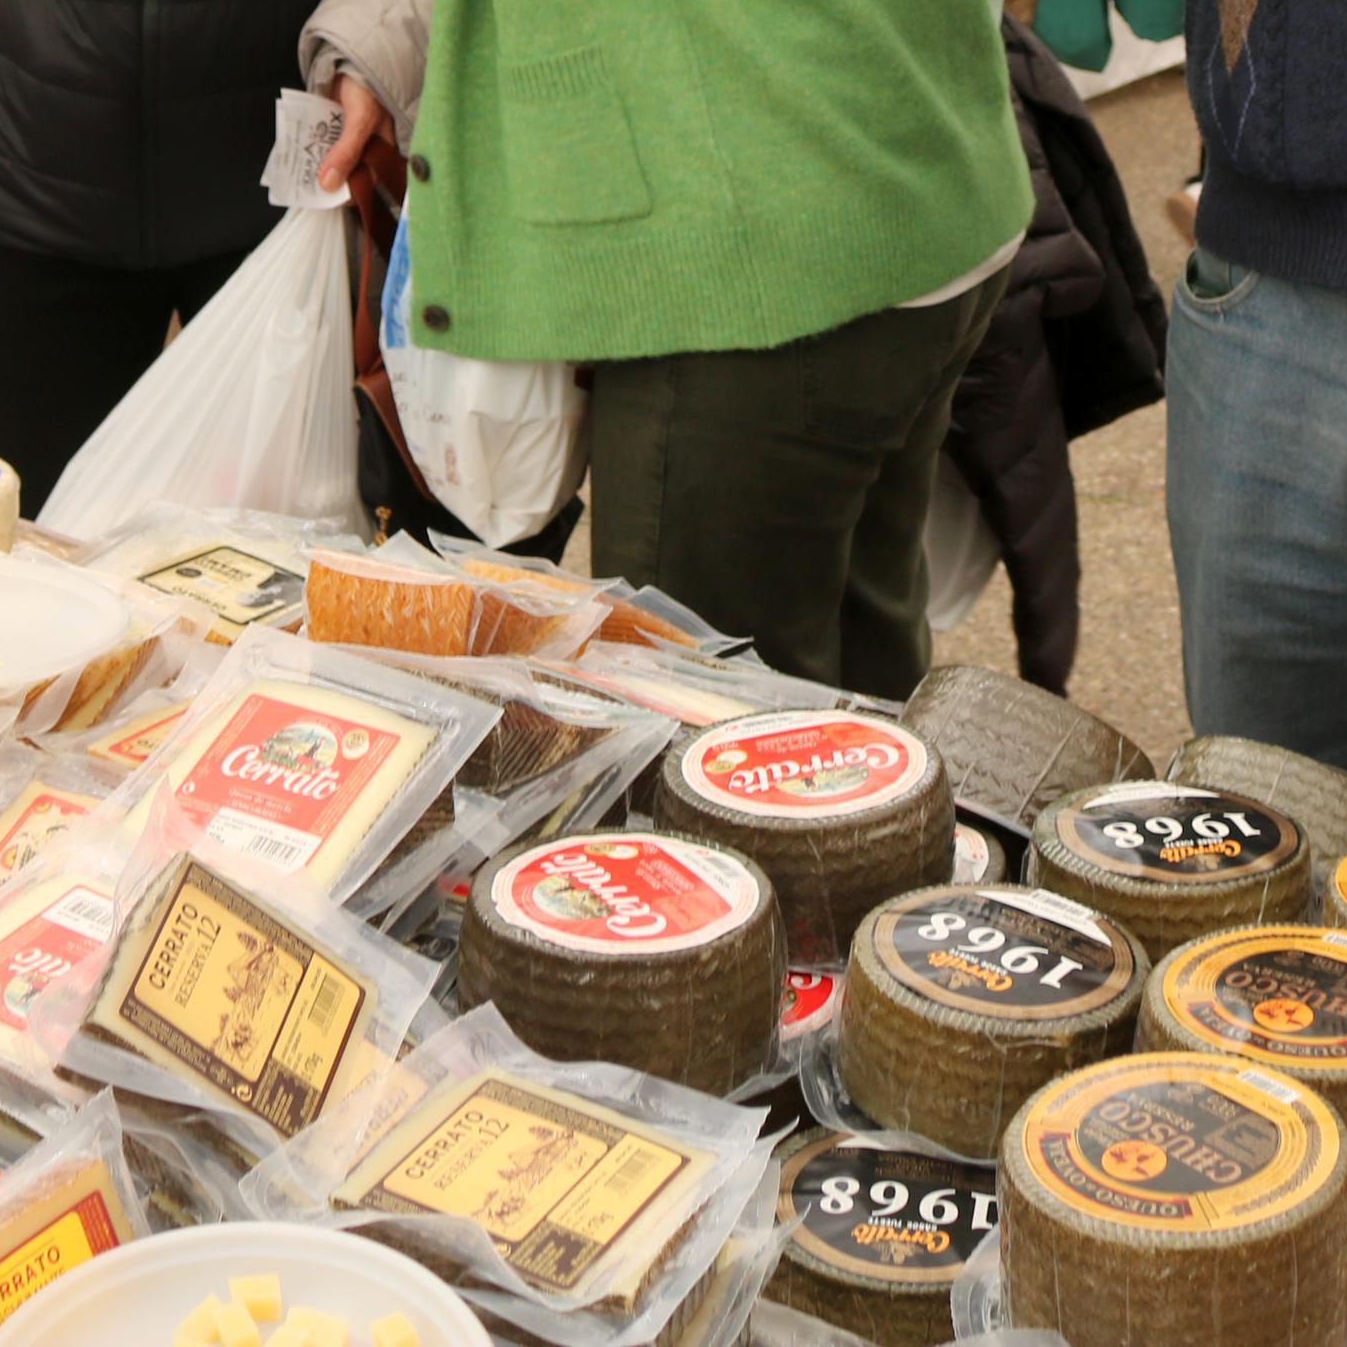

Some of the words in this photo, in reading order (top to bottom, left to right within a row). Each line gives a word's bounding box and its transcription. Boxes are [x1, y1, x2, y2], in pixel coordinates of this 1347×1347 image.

[221, 745, 340, 800] Cerrato
[728, 743, 899, 794] Cerrato
[1103, 812, 1261, 849] 1968
[541, 853, 667, 937] Cerrato
[149, 903, 198, 990] CERRATO
[174, 938, 215, 1009] RESERVA
[196, 915, 222, 942] 12
[918, 912, 1083, 989] 1968
[405, 1110, 484, 1179] CERRATO
[434, 1137, 494, 1190] RESERVA
[479, 1118, 510, 1141] 12
[1099, 1100, 1242, 1184] CHUSCO
[819, 1176, 999, 1230] 1968
[1095, 1187, 1178, 1217] QUESO
